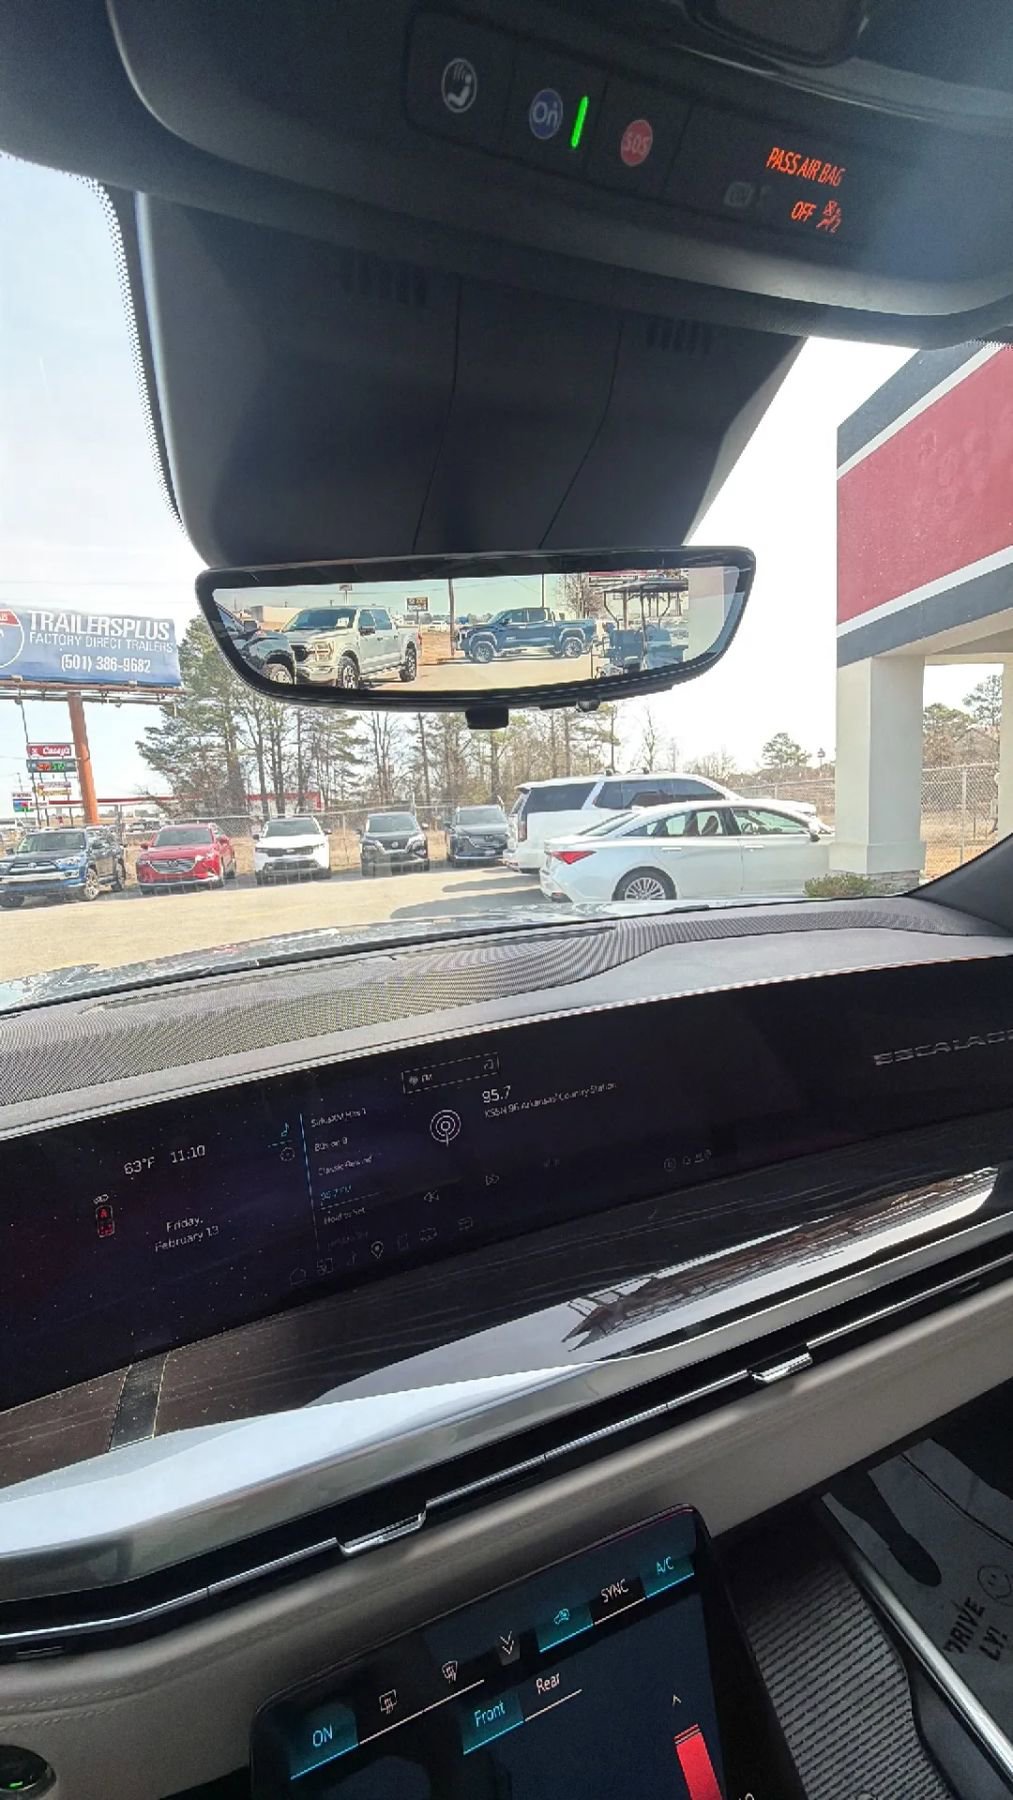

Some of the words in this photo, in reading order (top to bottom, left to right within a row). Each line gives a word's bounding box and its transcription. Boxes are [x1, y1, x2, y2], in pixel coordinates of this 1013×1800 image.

[623, 132, 650, 155] SOS
[766, 147, 801, 175] PASS
[797, 157, 821, 180] AIR
[818, 163, 846, 187] BAG
[791, 201, 816, 221] OFF
[27, 610, 170, 641] TRAILERSPLUS
[29, 631, 82, 647] FACTORY
[85, 637, 121, 650] DIRECT
[126, 639, 173, 653] TRAILERS
[61, 653, 92, 672] (501)
[95, 656, 150, 673] 386-9682
[482, 1085, 511, 1103] 95.7
[124, 1156, 155, 1175] 63°F
[169, 1145, 206, 1164] 11:10
[154, 1232, 204, 1252] February
[206, 1225, 220, 1238] 13
[655, 1556, 674, 1576] A/C
[601, 1579, 630, 1603] SYNC
[943, 1596, 984, 1654] DRIVE
[536, 1671, 561, 1694] Rear
[474, 1702, 506, 1727] Front
[312, 1724, 334, 1747] ON
